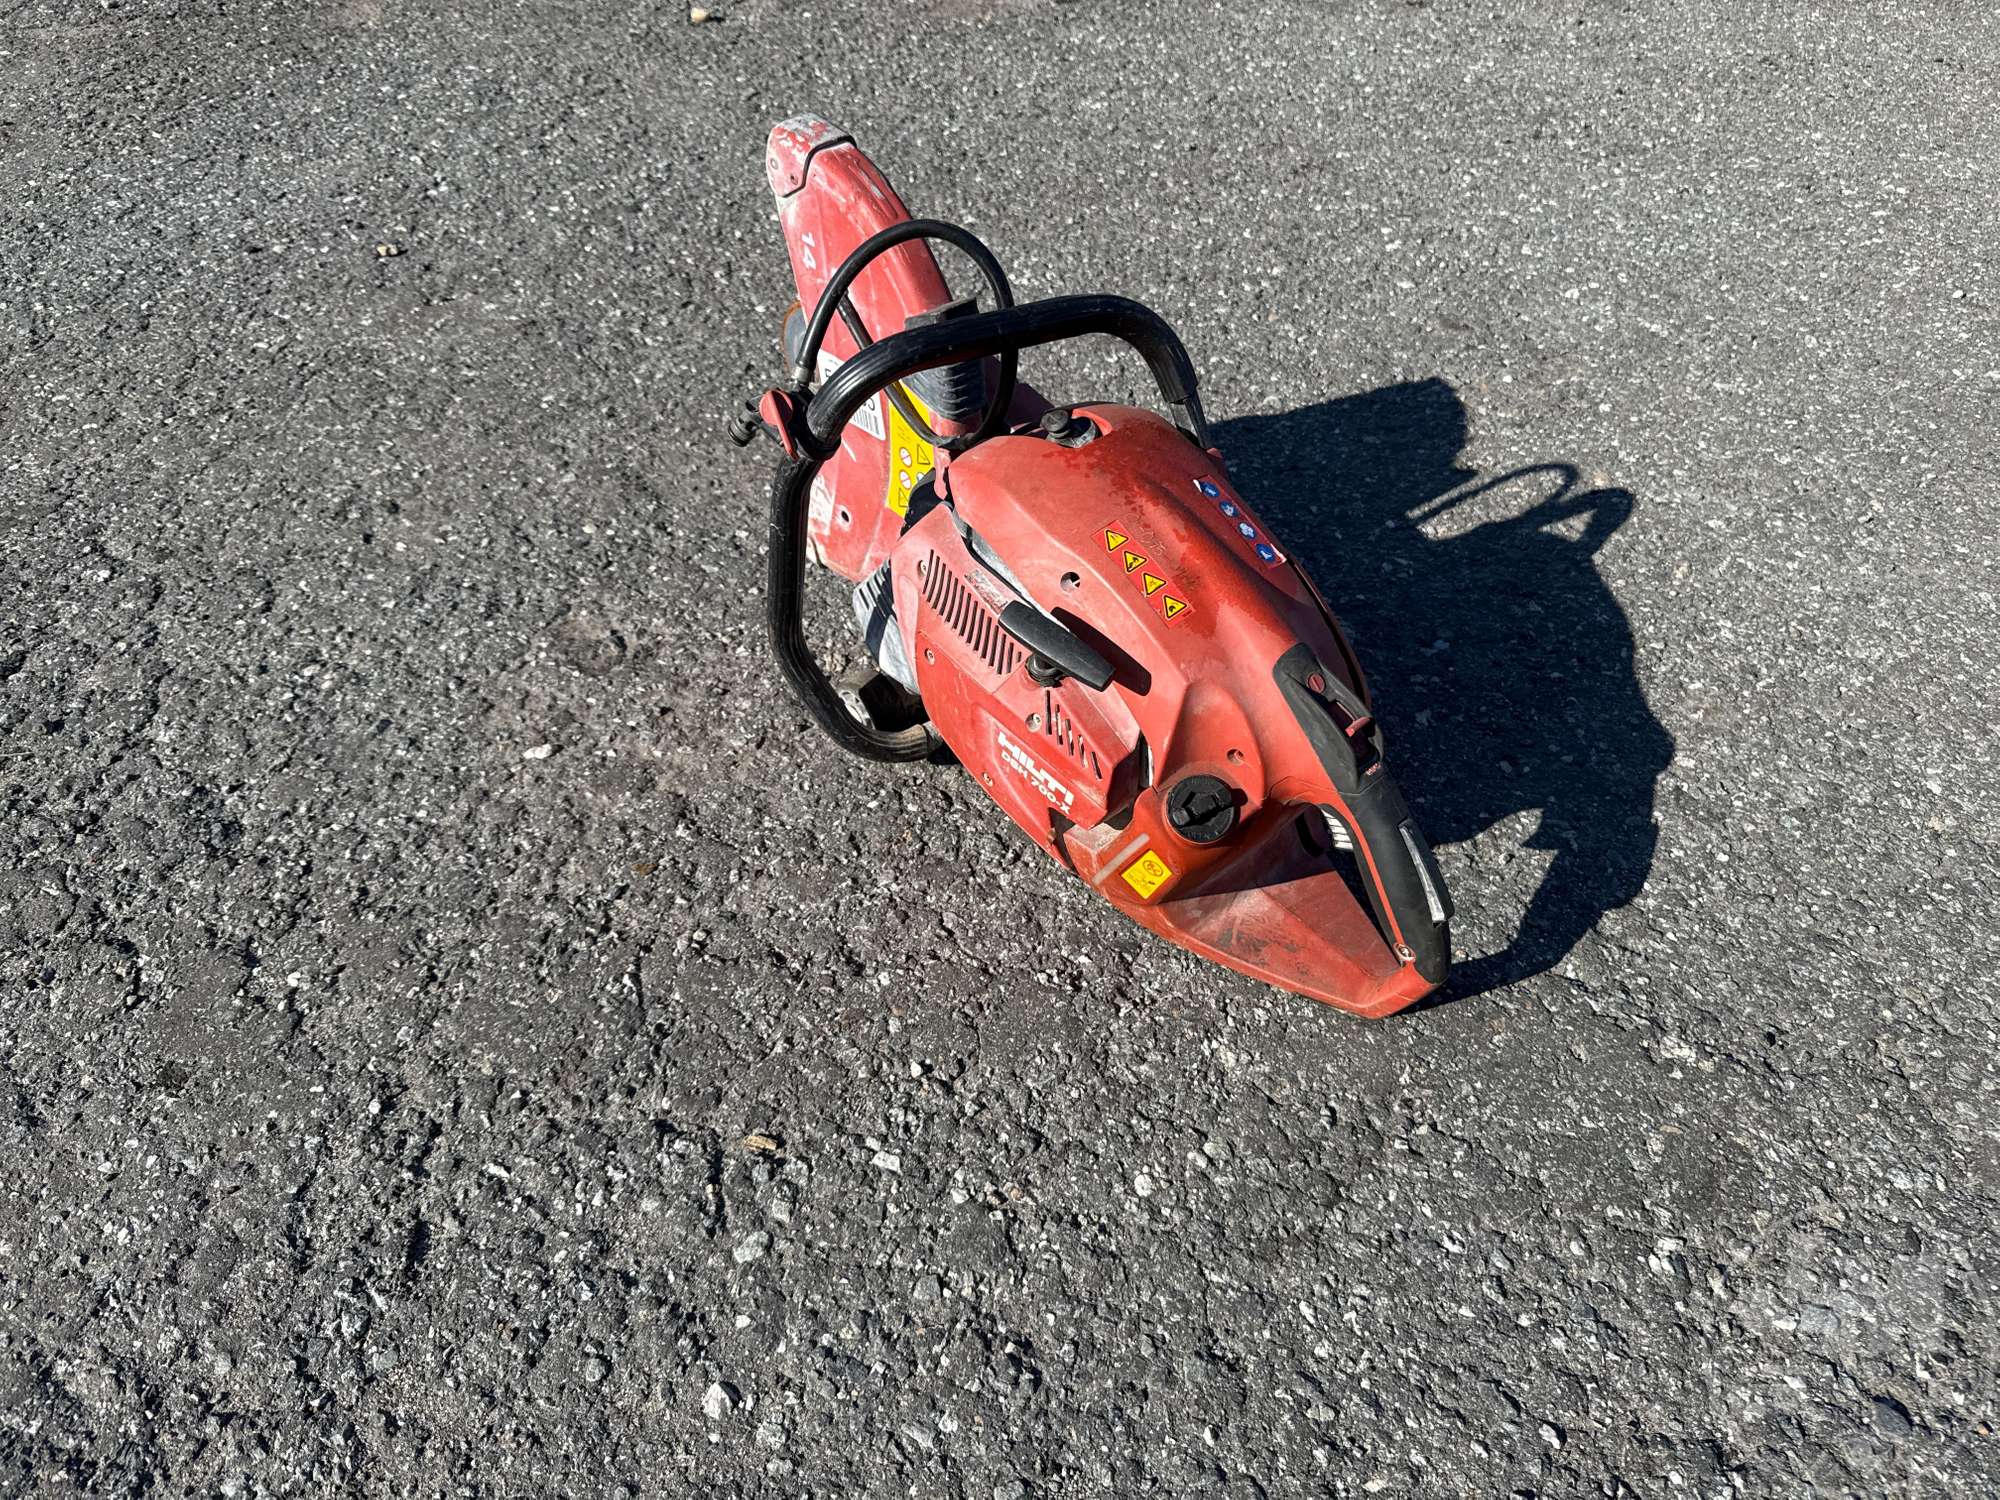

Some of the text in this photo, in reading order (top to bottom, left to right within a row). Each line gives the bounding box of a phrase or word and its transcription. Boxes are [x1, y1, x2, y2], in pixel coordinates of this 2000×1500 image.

[801, 231, 816, 269] 14
[998, 730, 1074, 806] HILTI
[1001, 750, 1071, 815] DSH 700-X
